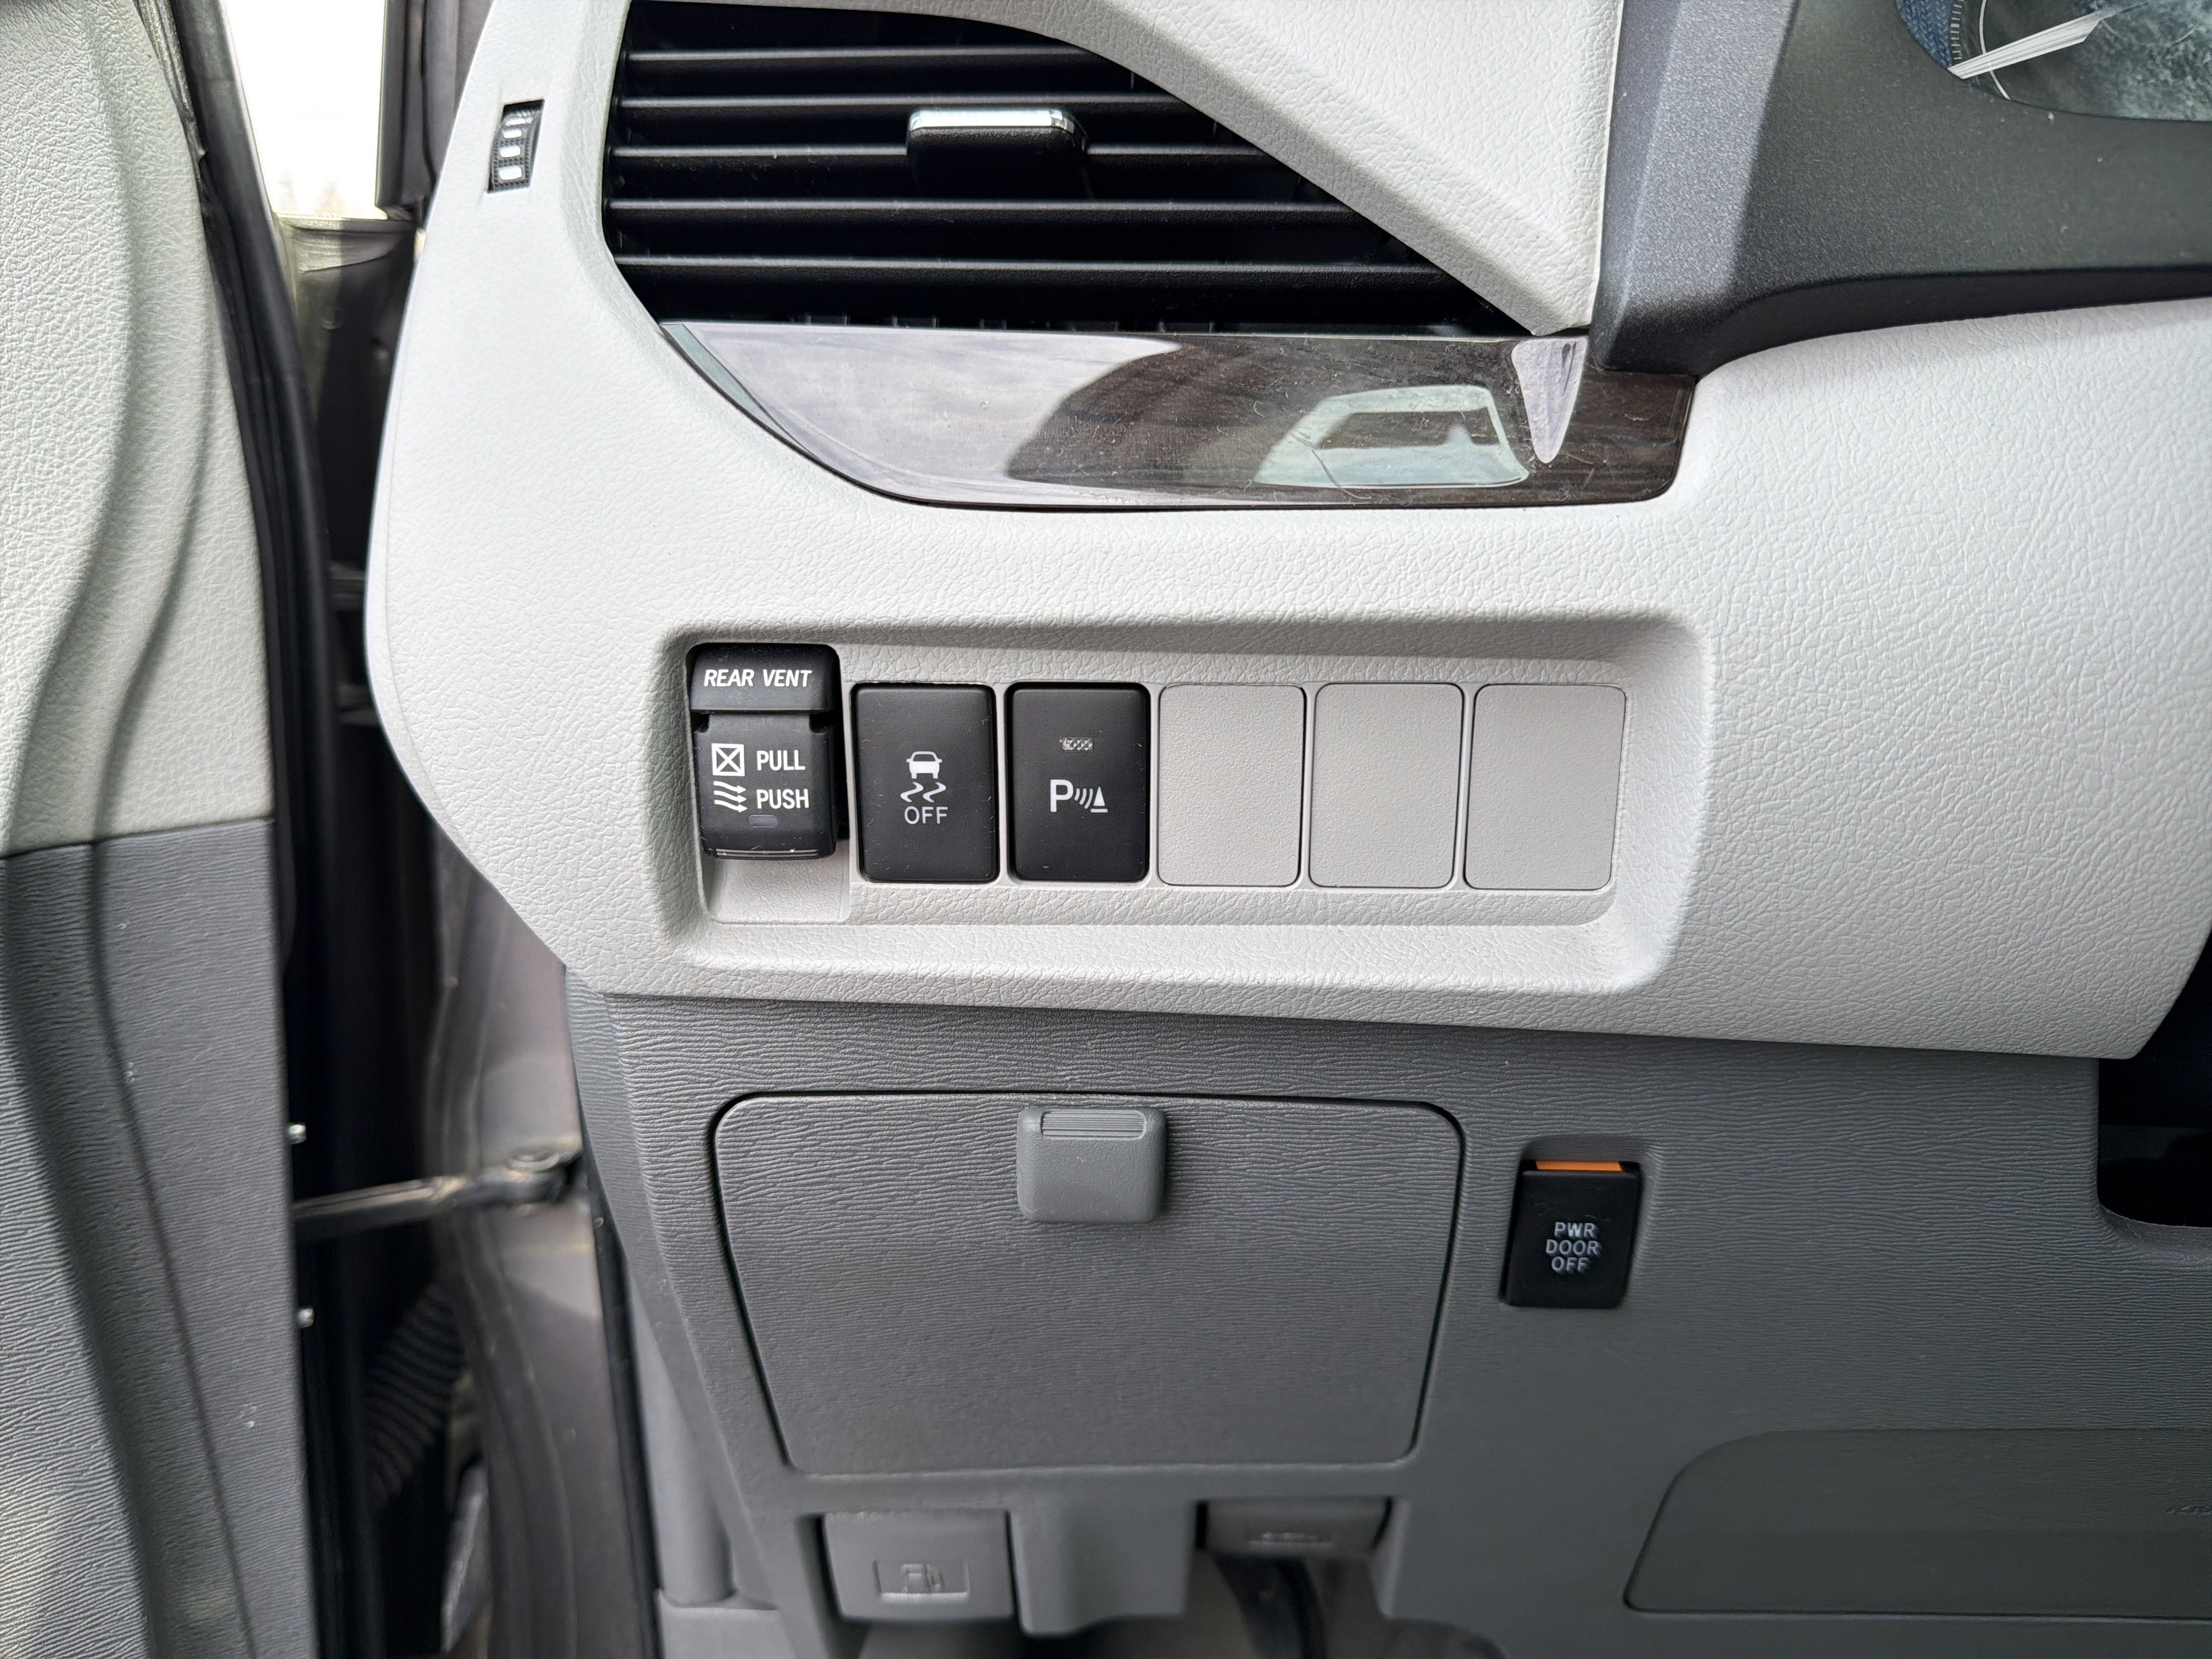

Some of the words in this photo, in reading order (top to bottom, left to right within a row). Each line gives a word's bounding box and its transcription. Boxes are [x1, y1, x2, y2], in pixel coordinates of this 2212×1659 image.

[703, 669, 755, 687] REAR
[763, 669, 813, 688] VENT
[757, 749, 806, 771] PULL
[756, 788, 810, 810] PUSH
[1050, 779, 1074, 812] P
[904, 806, 949, 825] OFF
[1554, 1221, 1598, 1238] PWR
[1545, 1238, 1601, 1256] DOOR
[1551, 1256, 1589, 1273] OFF
